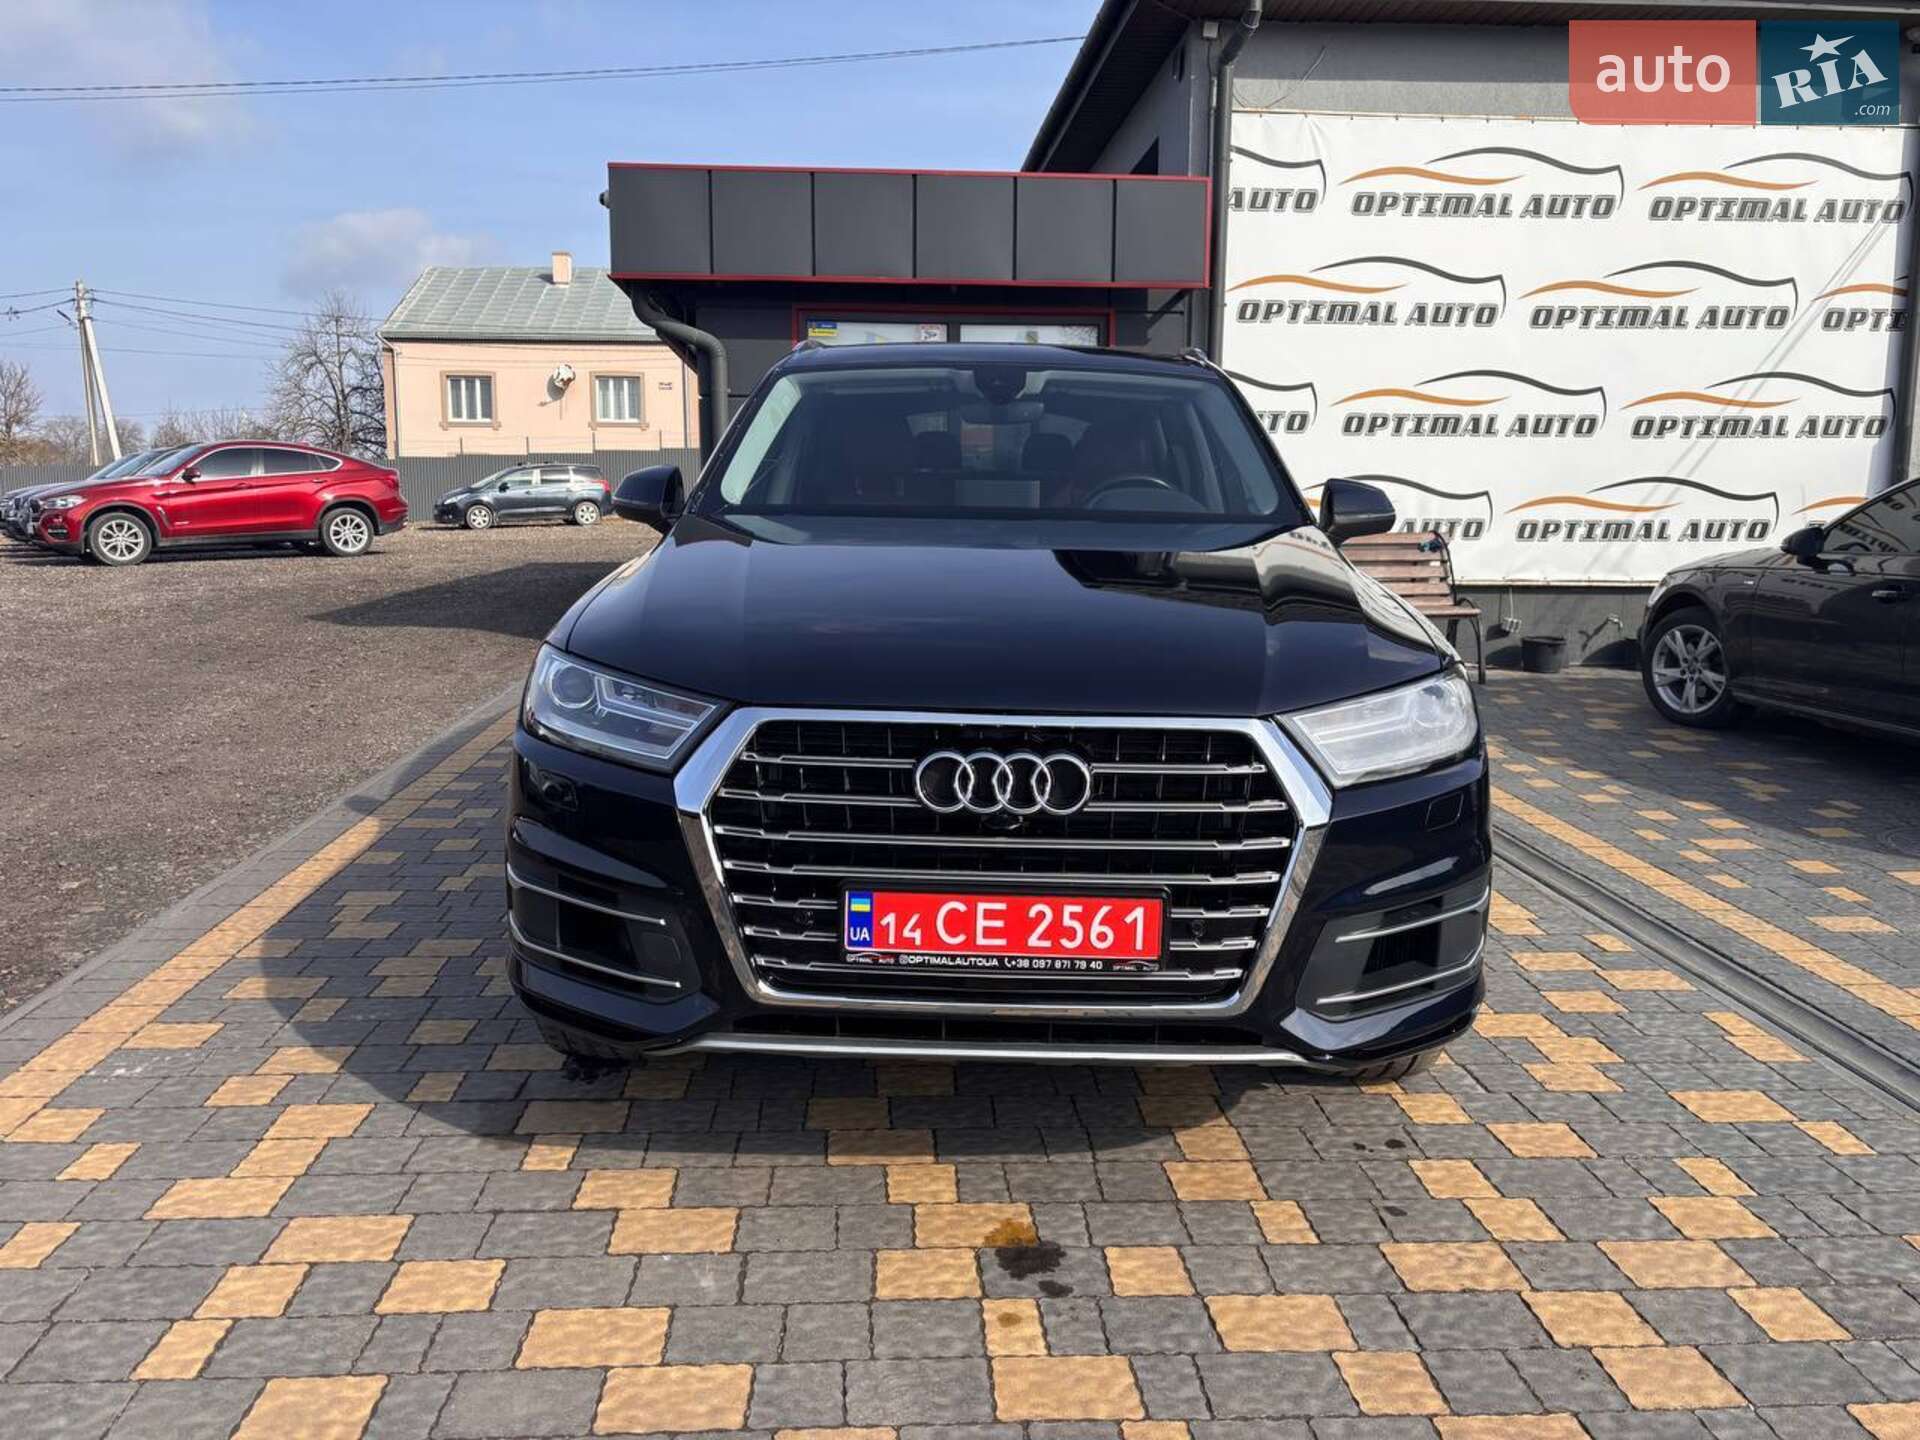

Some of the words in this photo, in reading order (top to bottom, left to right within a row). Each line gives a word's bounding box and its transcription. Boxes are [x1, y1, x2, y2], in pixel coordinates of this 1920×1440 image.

[1225, 187, 1319, 213] AUTO
[1351, 192, 1513, 219] OPTIMAL
[1519, 194, 1616, 219] AUTO
[1648, 196, 1808, 222] OPTIMAL
[1813, 199, 1905, 224] AUTO
[1236, 299, 1397, 326] OPTIMAL
[1404, 302, 1499, 327] AUTO
[1528, 305, 1688, 330] OPTIMAL
[1694, 306, 1790, 331] AUTO
[1256, 410, 1311, 434] TO
[1342, 412, 1499, 437] OPTIMAL
[1505, 414, 1599, 438] AUTO
[1630, 415, 1789, 440] OPTIMAL
[1795, 415, 1889, 439] AUTO
[1515, 518, 1672, 543] OPTIMAL
[1677, 519, 1771, 543] AUTO
[850, 927, 870, 942] UA
[879, 912, 922, 946] 14
[935, 900, 1008, 946] CE
[1027, 903, 1145, 951] 2561
[1032, 959, 1052, 969] 097
[1089, 961, 1104, 970] 40
